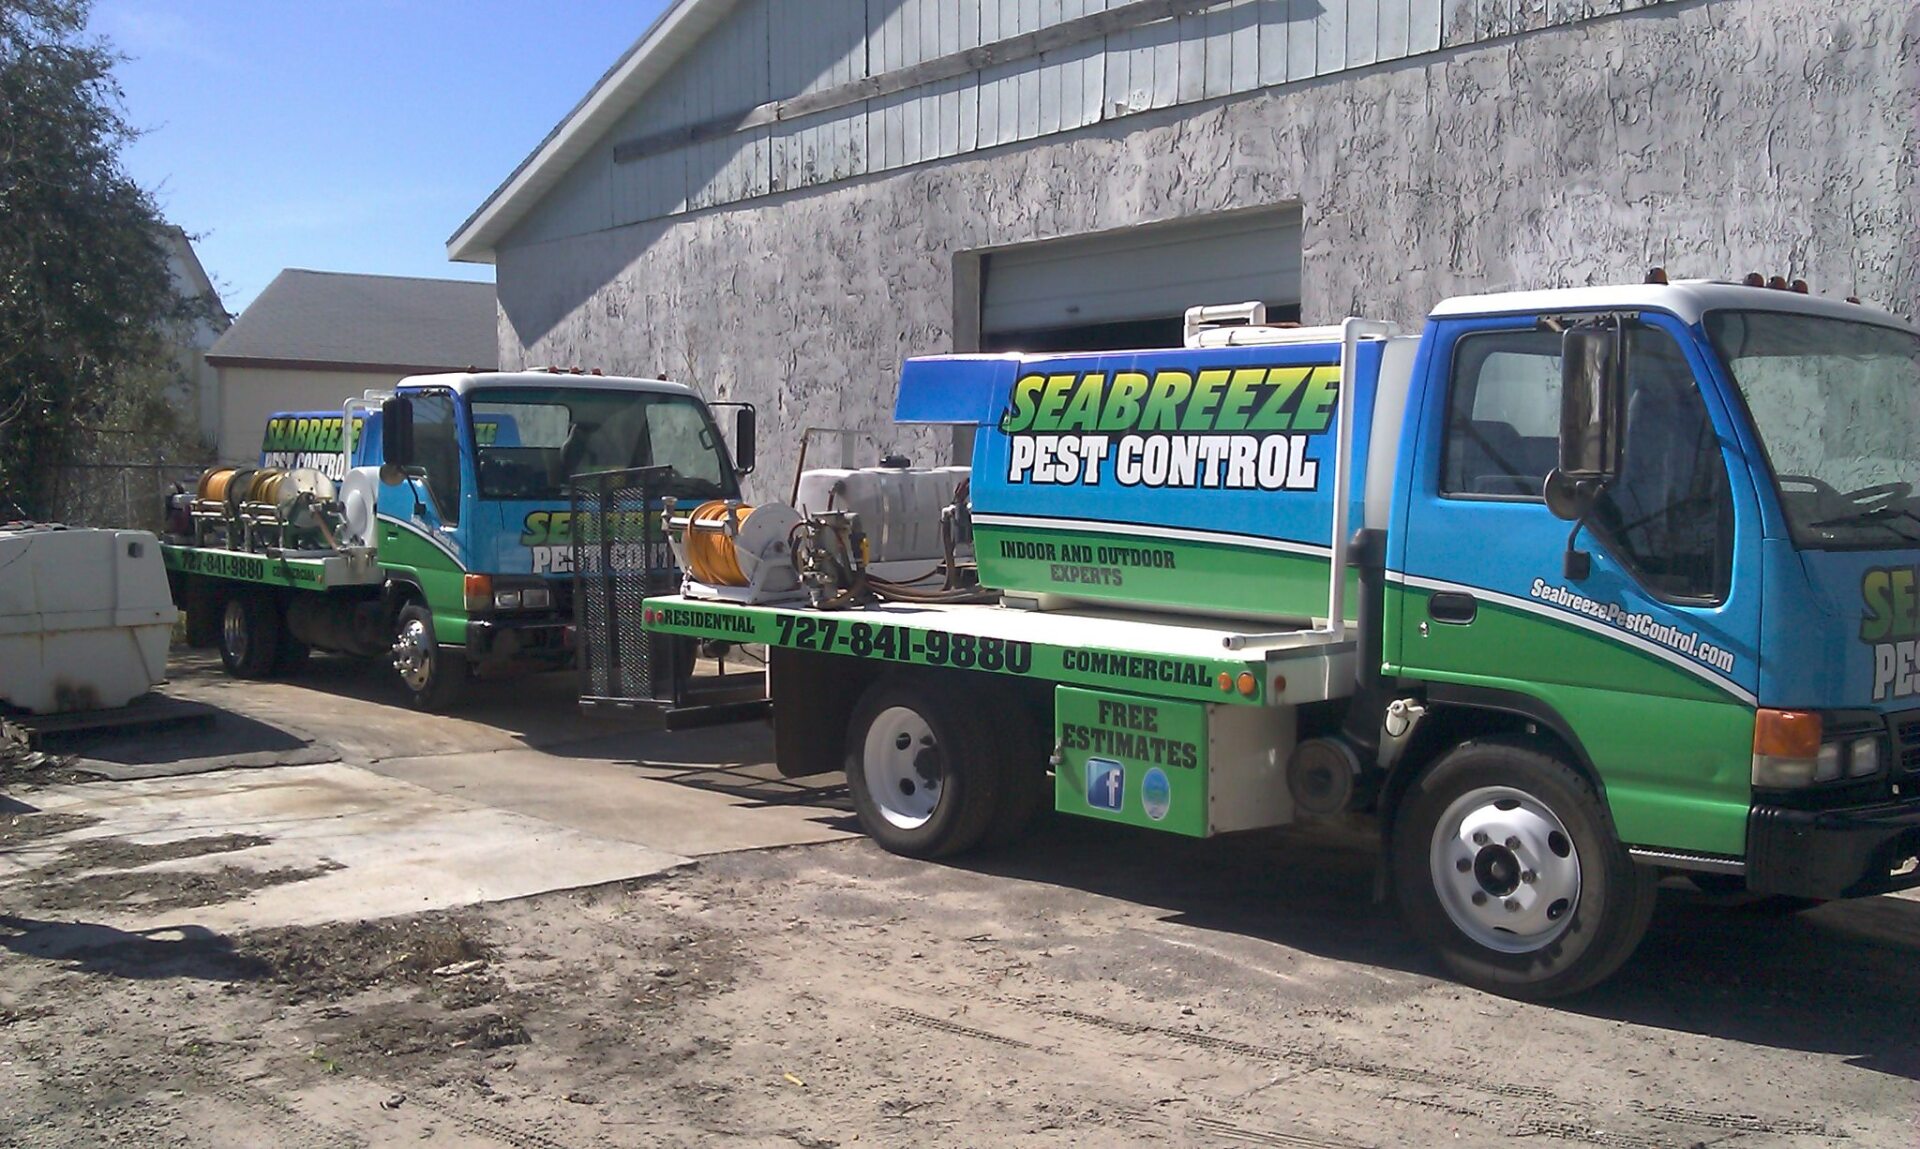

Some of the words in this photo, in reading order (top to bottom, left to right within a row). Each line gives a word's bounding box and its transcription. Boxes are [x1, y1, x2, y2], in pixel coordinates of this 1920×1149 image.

[1001, 364, 1341, 433] SEABREEZE
[263, 417, 363, 452] SEABREEE
[296, 453, 345, 480] CONTRO
[1008, 434, 1109, 485] PEST
[1116, 434, 1319, 490] CONTROL
[182, 551, 264, 580] 727-841-9880
[1000, 540, 1056, 561] INDOOR
[1061, 544, 1093, 563] AND
[1098, 546, 1176, 569] OUTDOOR
[1050, 564, 1123, 586] EXPERTS
[1861, 568, 1920, 642] SE
[1531, 578, 1735, 674] SeabreezePestControl.com
[664, 611, 755, 634] RESIDENTIAL
[776, 614, 1032, 674] 727-841-9880
[1062, 650, 1213, 687] COMMERCIAL
[1098, 699, 1158, 733] FREE
[1061, 723, 1197, 770] ESTIMATES
